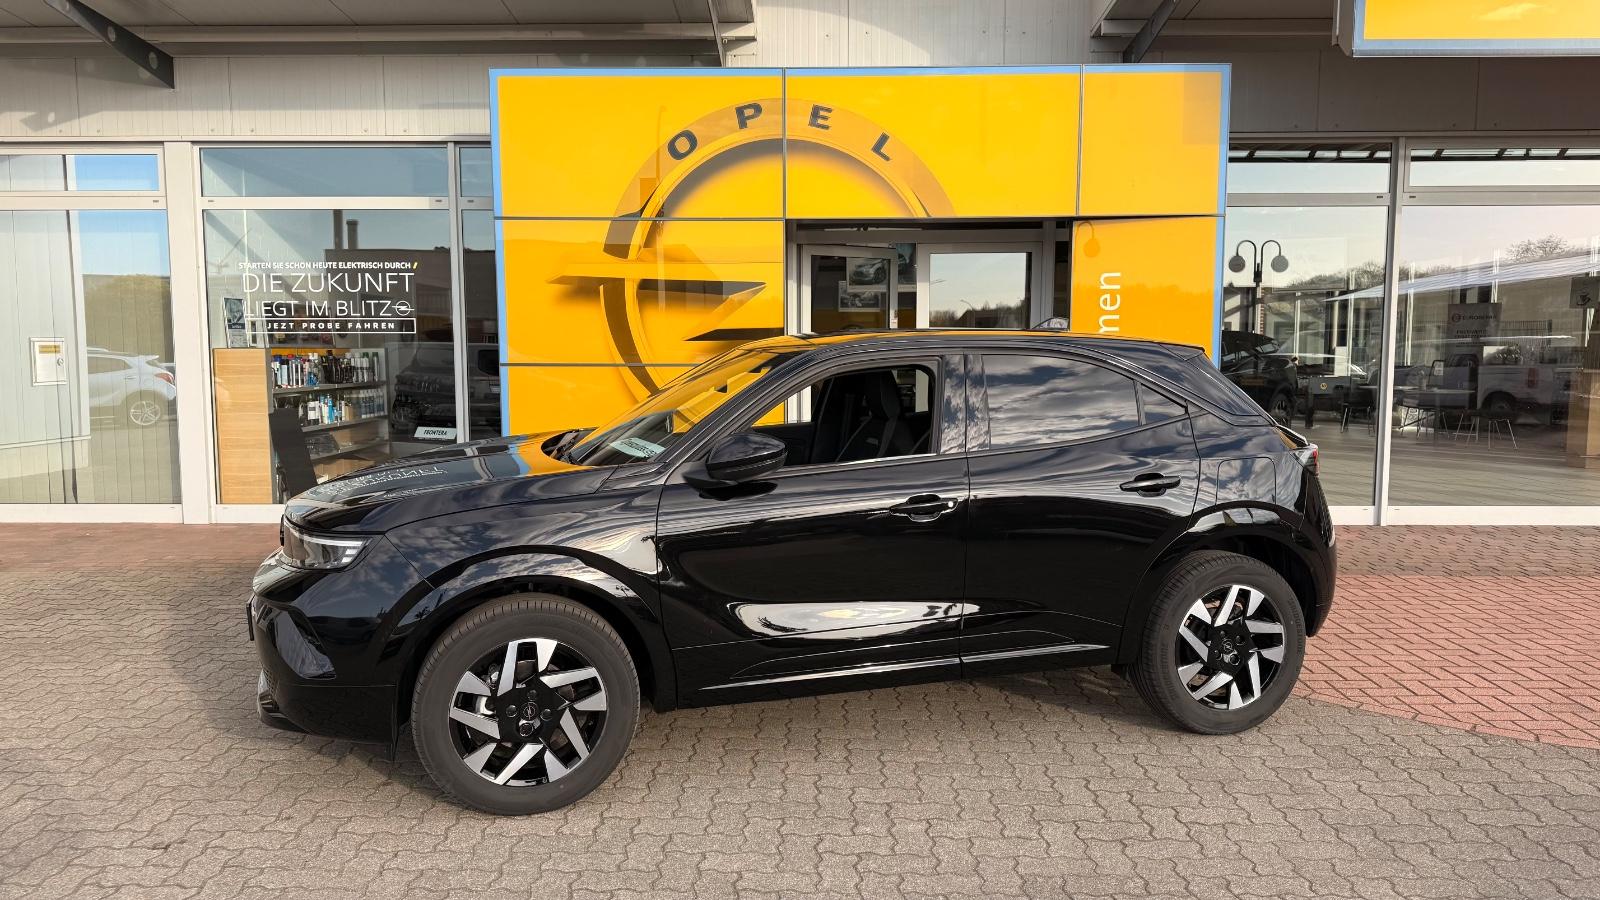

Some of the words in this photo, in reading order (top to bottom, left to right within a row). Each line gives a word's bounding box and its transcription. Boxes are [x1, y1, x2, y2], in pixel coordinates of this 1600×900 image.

[667, 102, 893, 162] OPEL
[242, 272, 284, 293] DIE
[290, 272, 415, 293] ZUKUNFT
[244, 300, 299, 317] LIEGT
[305, 300, 329, 317] IM
[336, 300, 393, 317] BLITZ
